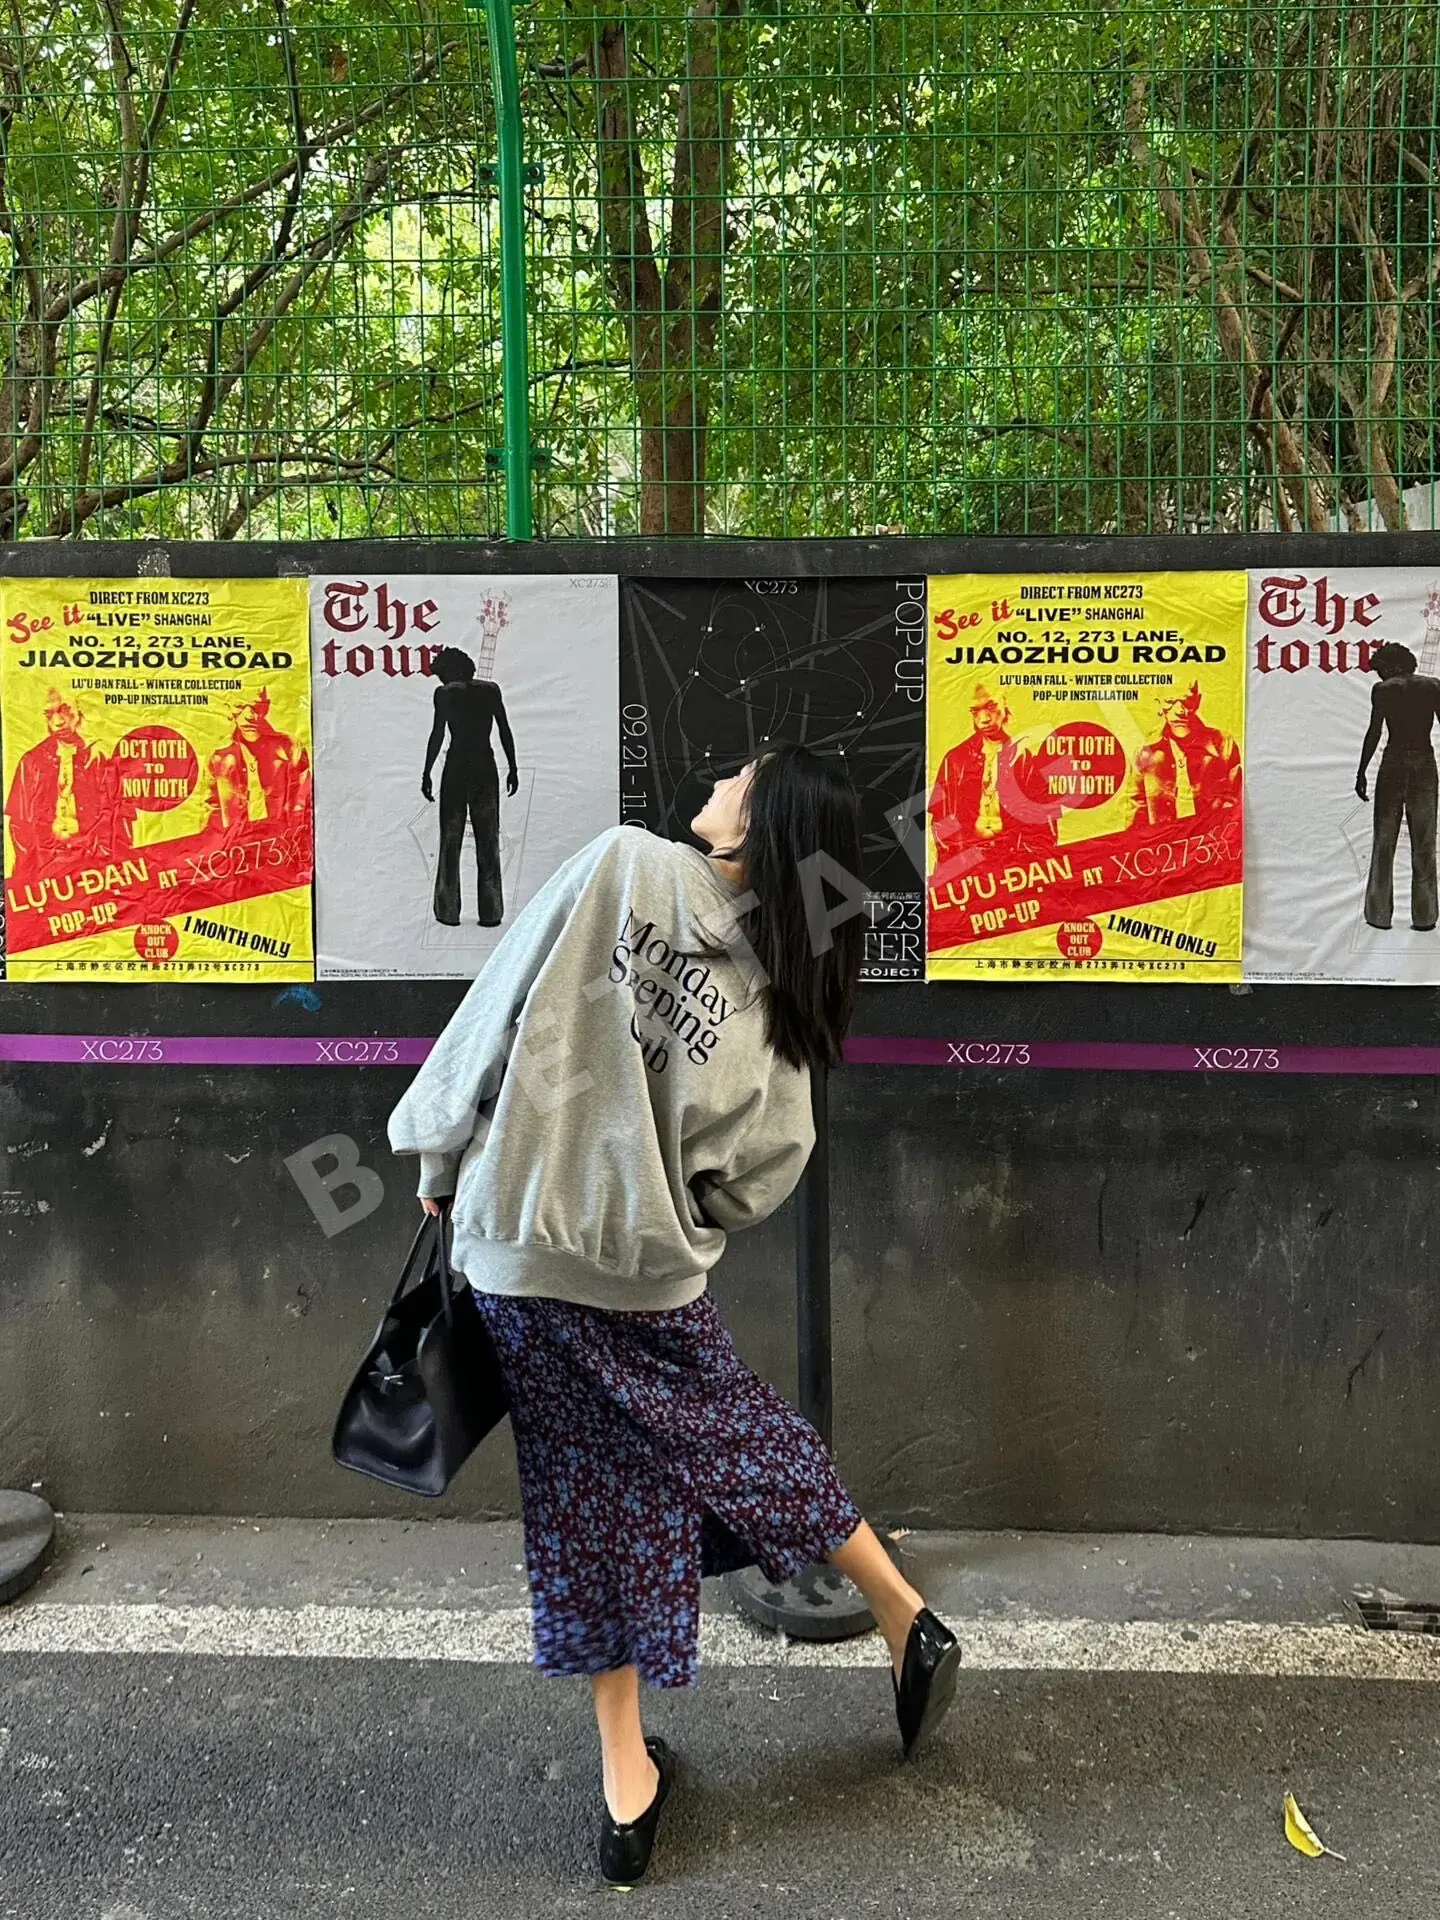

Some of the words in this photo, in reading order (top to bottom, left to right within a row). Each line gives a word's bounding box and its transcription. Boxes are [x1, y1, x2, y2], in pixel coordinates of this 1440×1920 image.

[90, 591, 133, 605] DIRECT
[136, 591, 169, 605] FROM
[172, 591, 209, 605] XC273
[1020, 586, 1064, 599] DIRECT
[1067, 586, 1101, 599] FROM
[1104, 585, 1143, 599] XC273
[323, 580, 441, 640] The
[1085, 608, 1144, 621] SHANGHAI
[1259, 574, 1382, 635] The
[6, 612, 55, 643] See
[63, 603, 85, 625] it
[154, 613, 211, 626] SHANGHAI
[934, 609, 983, 640] See
[991, 598, 1014, 621] it
[69, 636, 104, 647] NO.
[112, 636, 141, 650] 12,
[148, 636, 184, 647] 273
[191, 636, 252, 650] LANE,
[895, 581, 925, 703] POP-UP
[998, 632, 1033, 643] NO.
[1041, 631, 1071, 645] 12,
[1078, 631, 1115, 643] 273
[1122, 630, 1185, 645] LANE,
[19, 651, 188, 668] JIAOZHOU
[202, 651, 292, 668] ROAD
[321, 638, 444, 677] tour
[945, 646, 1119, 664] JIAOZHOU
[1132, 645, 1226, 663] ROAD
[1253, 634, 1384, 674] tour
[116, 679, 138, 690] FALL
[146, 679, 182, 690] WINTER
[184, 679, 242, 690] COLLECTION
[1044, 675, 1067, 685] FALL
[1075, 675, 1112, 685] WINTER
[1114, 674, 1173, 685] COLLECTION
[105, 694, 140, 705] POP-UP
[141, 694, 208, 705] INSTALLATION
[1033, 690, 1068, 701] POP-UP
[1070, 689, 1138, 701] INSTALLATION
[622, 704, 648, 769] 09.21
[1046, 736, 1076, 755] OCT
[1078, 736, 1115, 755] 10TH
[119, 739, 149, 759] OCT
[152, 739, 187, 759] 10TH
[144, 763, 165, 774] TO
[1070, 760, 1091, 771] TO
[122, 778, 151, 798] NOV
[154, 778, 188, 798] 10TH
[1048, 775, 1078, 795] NOV
[1080, 775, 1115, 795] 10TH
[158, 869, 178, 890] AT
[1083, 867, 1103, 888] AT
[48, 902, 118, 936] POP-UP
[970, 899, 1041, 934] POP-UP
[141, 924, 171, 935] KNOCK
[183, 916, 192, 931] 1
[193, 918, 249, 947] MONTH
[250, 934, 291, 958] ONLY
[1063, 922, 1095, 933] KNOCK
[1107, 914, 1116, 930] 1
[1116, 916, 1171, 947] MONTH
[1175, 932, 1217, 958] ONLY
[147, 936, 165, 947] OUT
[863, 933, 922, 961] TER
[1070, 934, 1088, 945] OUT
[144, 948, 169, 959] CLUB
[1067, 947, 1092, 958] CLUB
[618, 906, 737, 1026] Monday
[859, 967, 920, 977] ROJECT
[81, 1040, 163, 1060] XC273
[315, 1041, 399, 1061] XC273
[947, 1043, 1031, 1065] XC273
[1193, 1048, 1280, 1070] XC273
